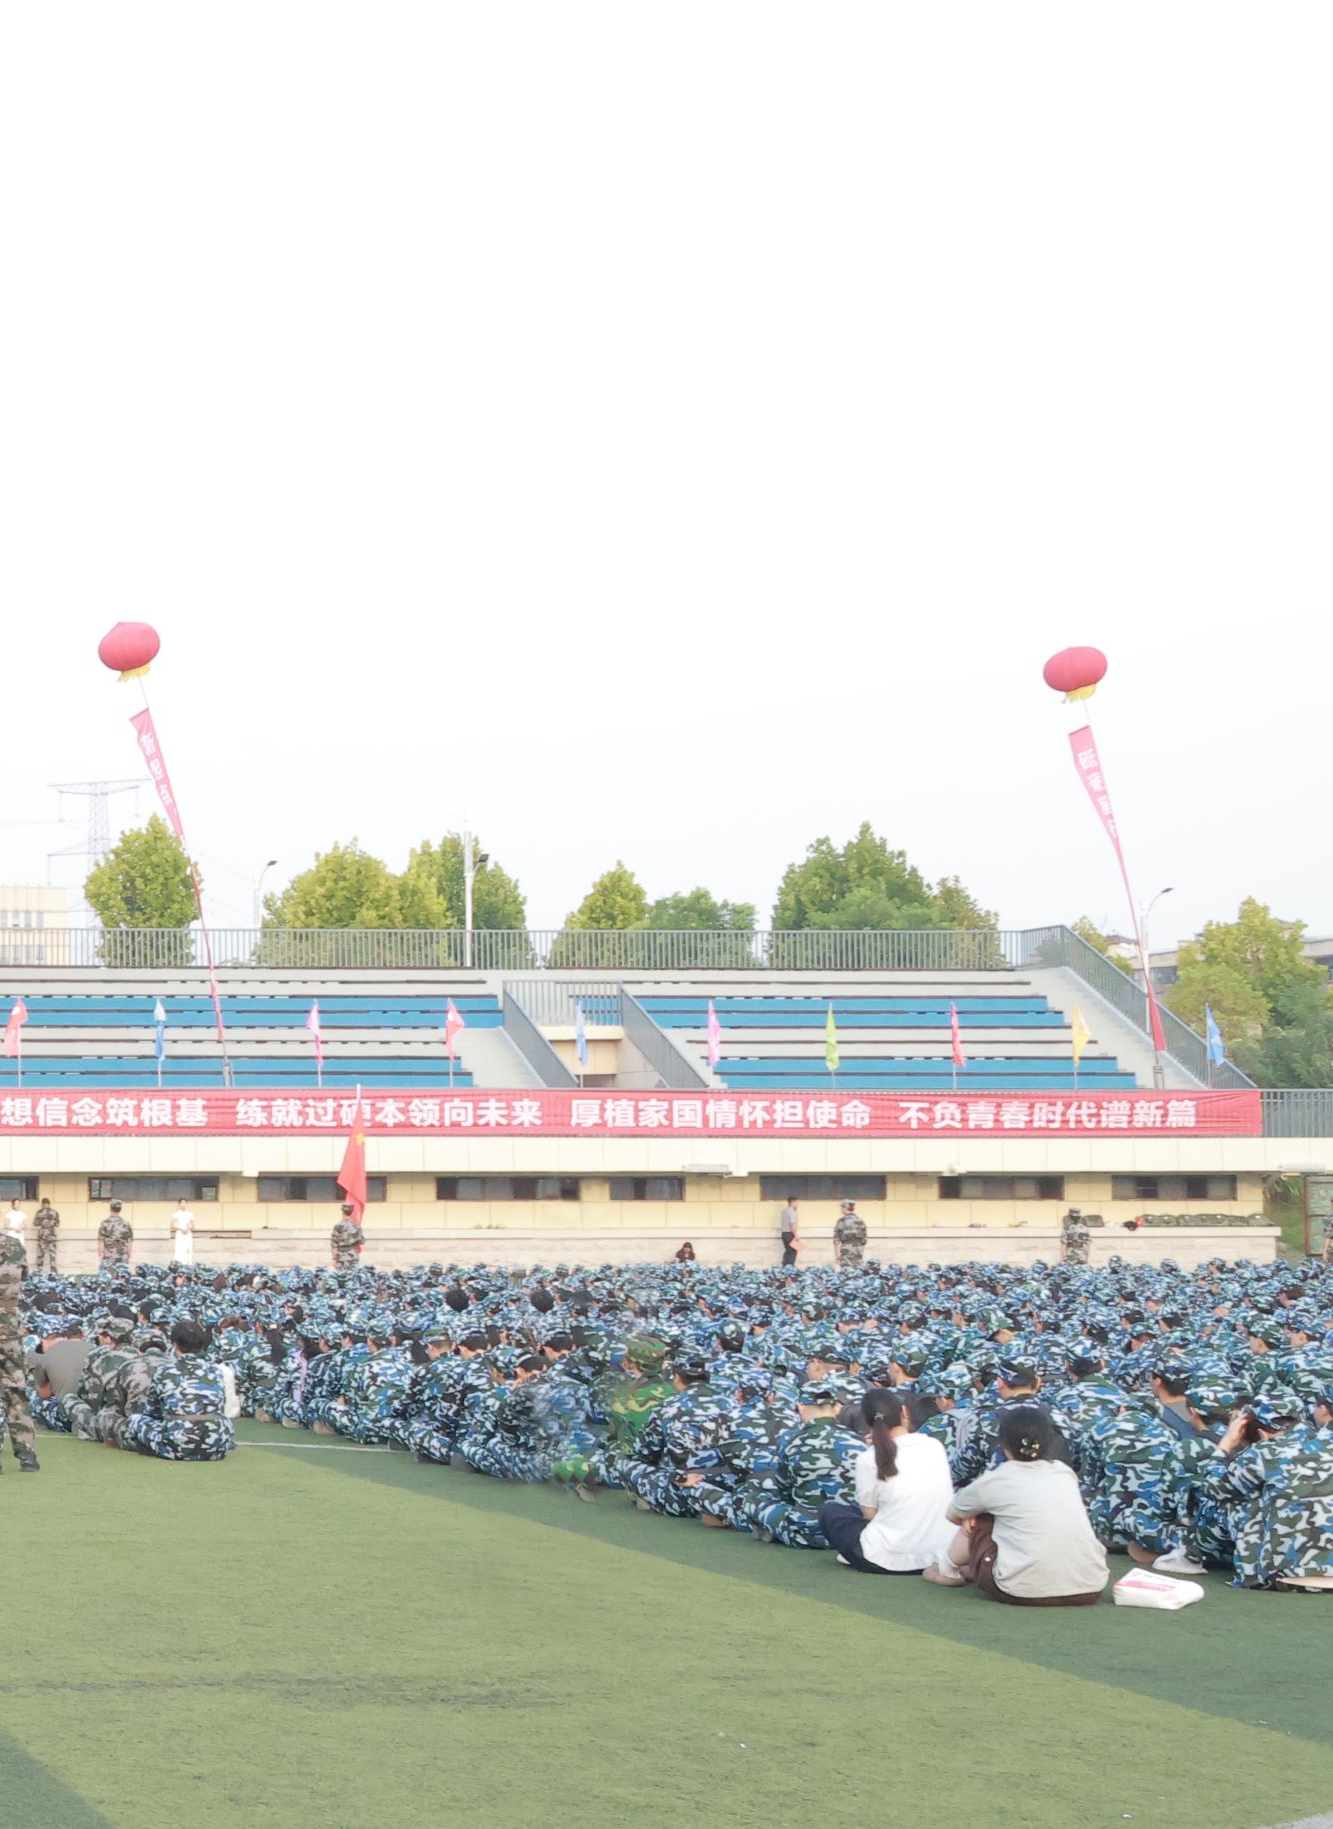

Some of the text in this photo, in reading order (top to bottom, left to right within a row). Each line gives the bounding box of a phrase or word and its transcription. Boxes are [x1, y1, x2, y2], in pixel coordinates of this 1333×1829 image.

[236, 1097, 543, 1128] 练就过硬本领向未来
[570, 1099, 871, 1129] 厚植家国情怀担使命
[899, 1100, 1197, 1129] 不负青春时代谱新篇
